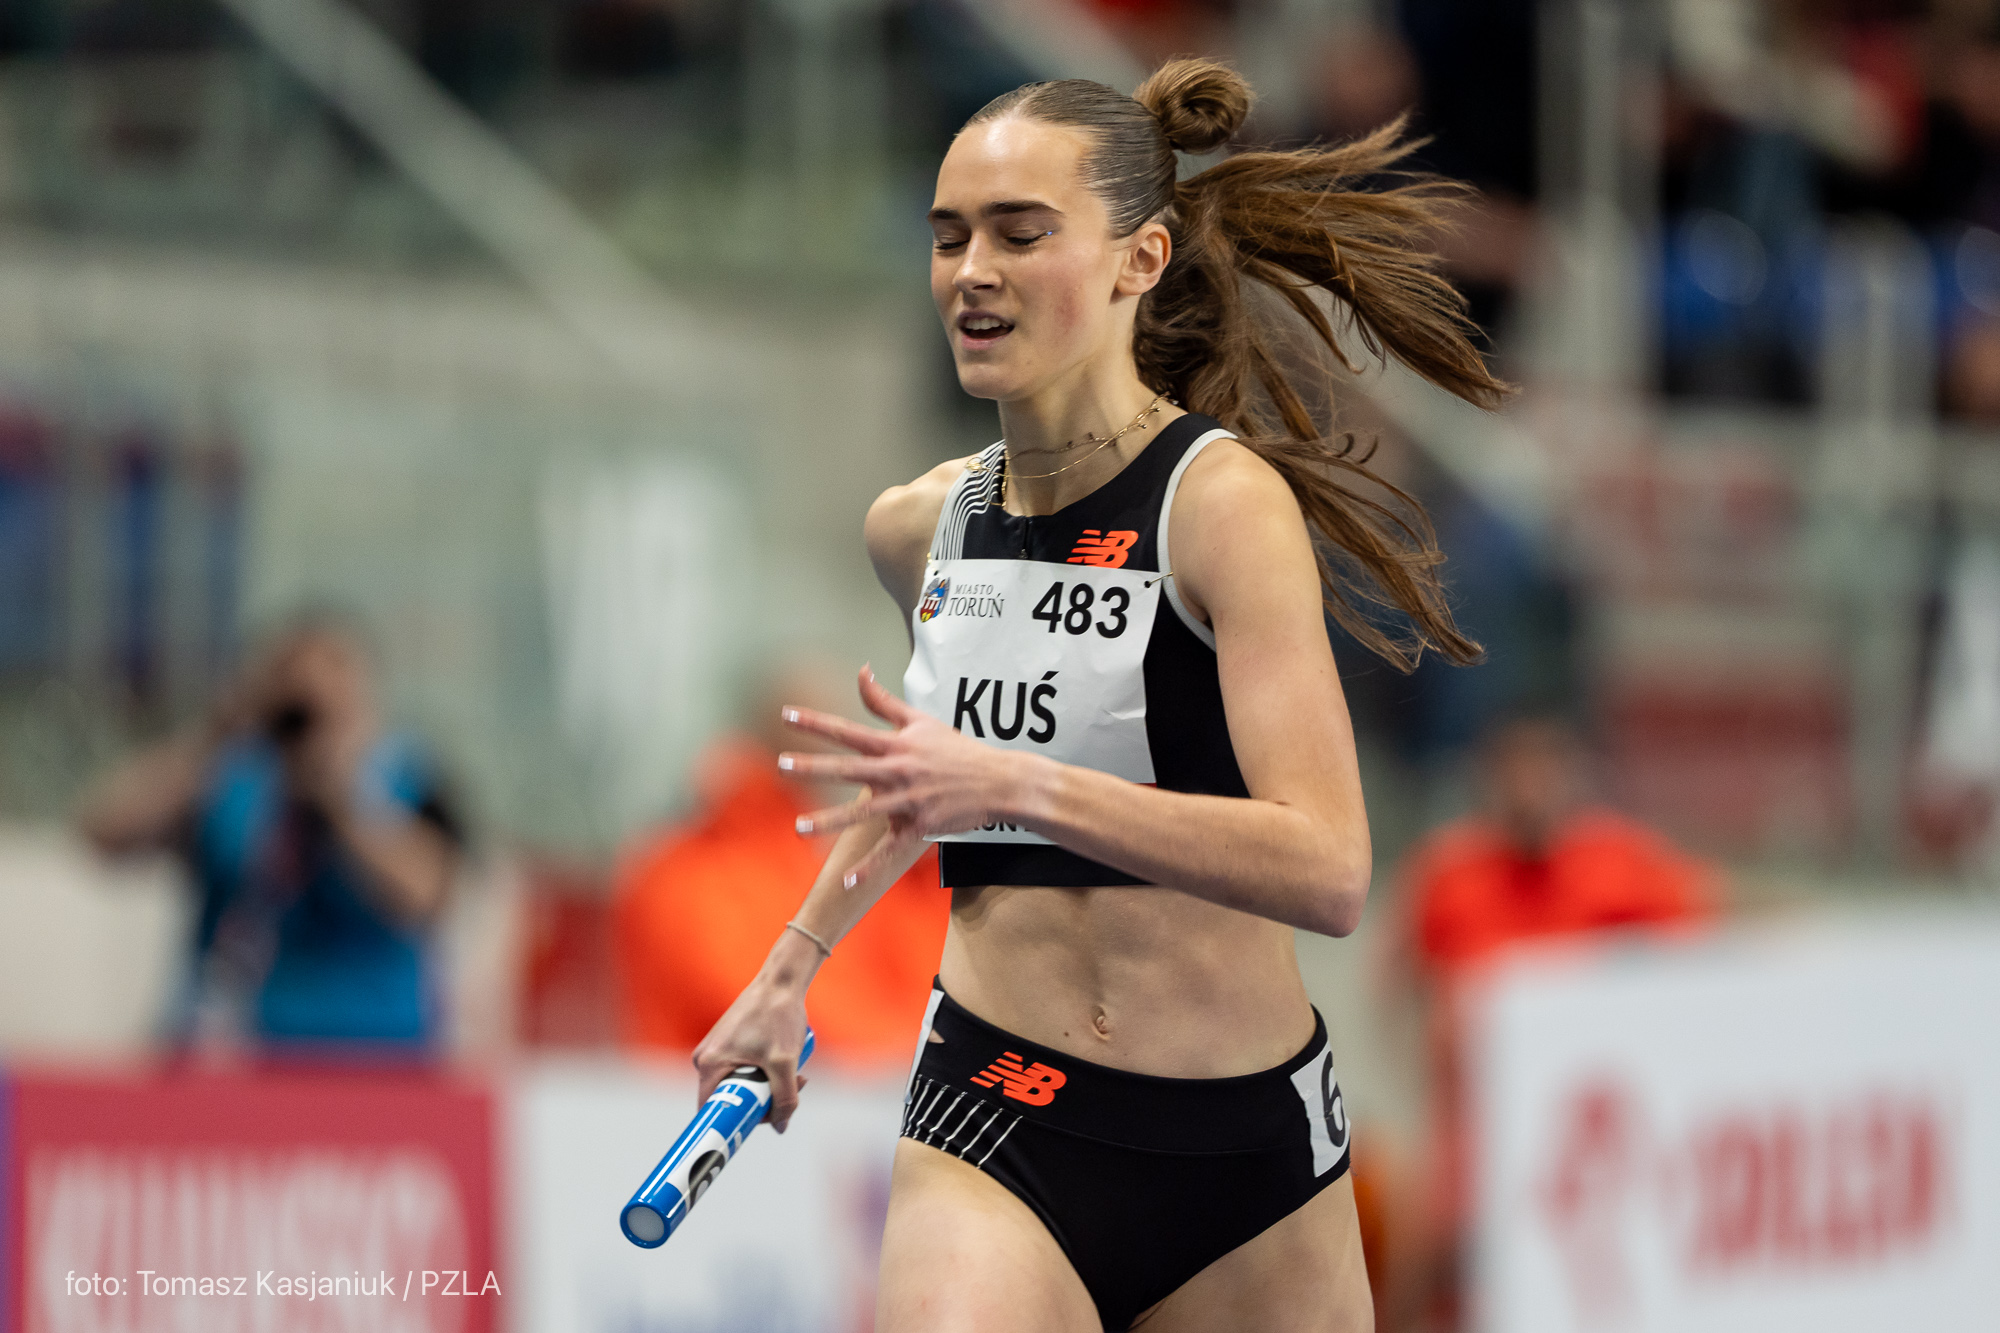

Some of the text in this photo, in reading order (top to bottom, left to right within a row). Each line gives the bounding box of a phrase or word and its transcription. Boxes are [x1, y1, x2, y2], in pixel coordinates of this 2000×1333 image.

[947, 592, 1005, 618] TORUŃ
[954, 584, 995, 595] MIASTO
[1031, 581, 1130, 639] 483
[953, 670, 1060, 744] KUŚ
[1320, 1050, 1346, 1148] 6
